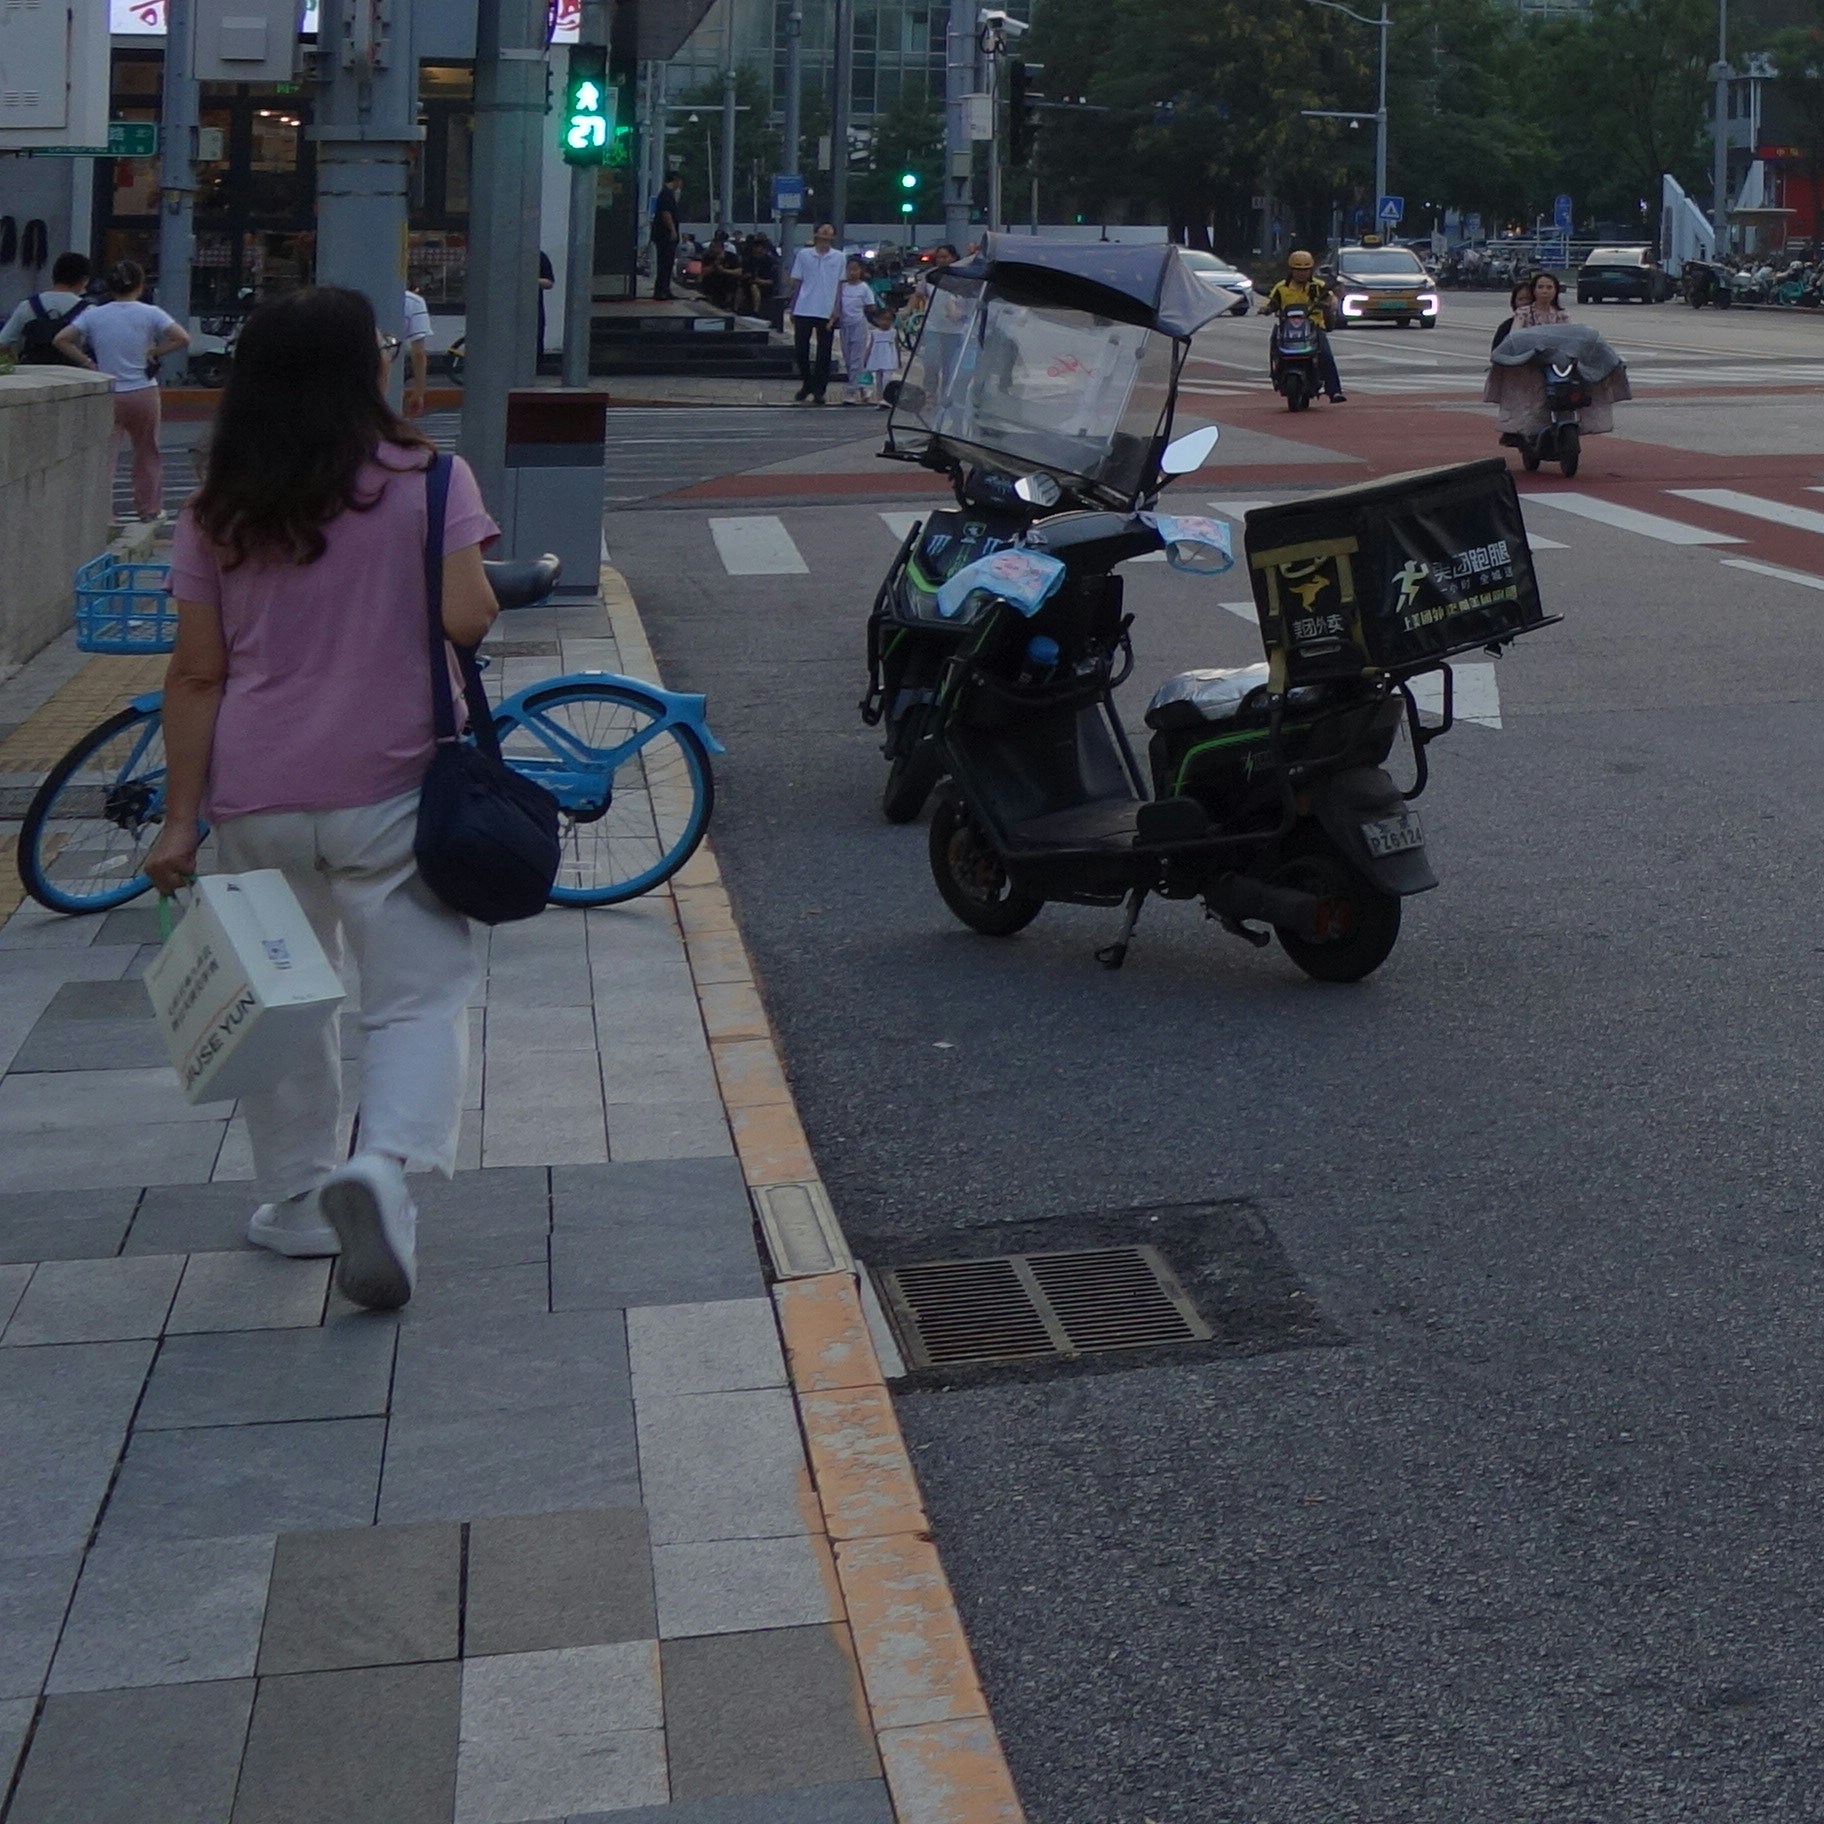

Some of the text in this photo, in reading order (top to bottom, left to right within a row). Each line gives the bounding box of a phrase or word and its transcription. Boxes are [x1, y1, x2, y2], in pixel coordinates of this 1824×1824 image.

[1433, 540, 1512, 583] 美团跑腿
[1292, 614, 1344, 639] 美团外卖
